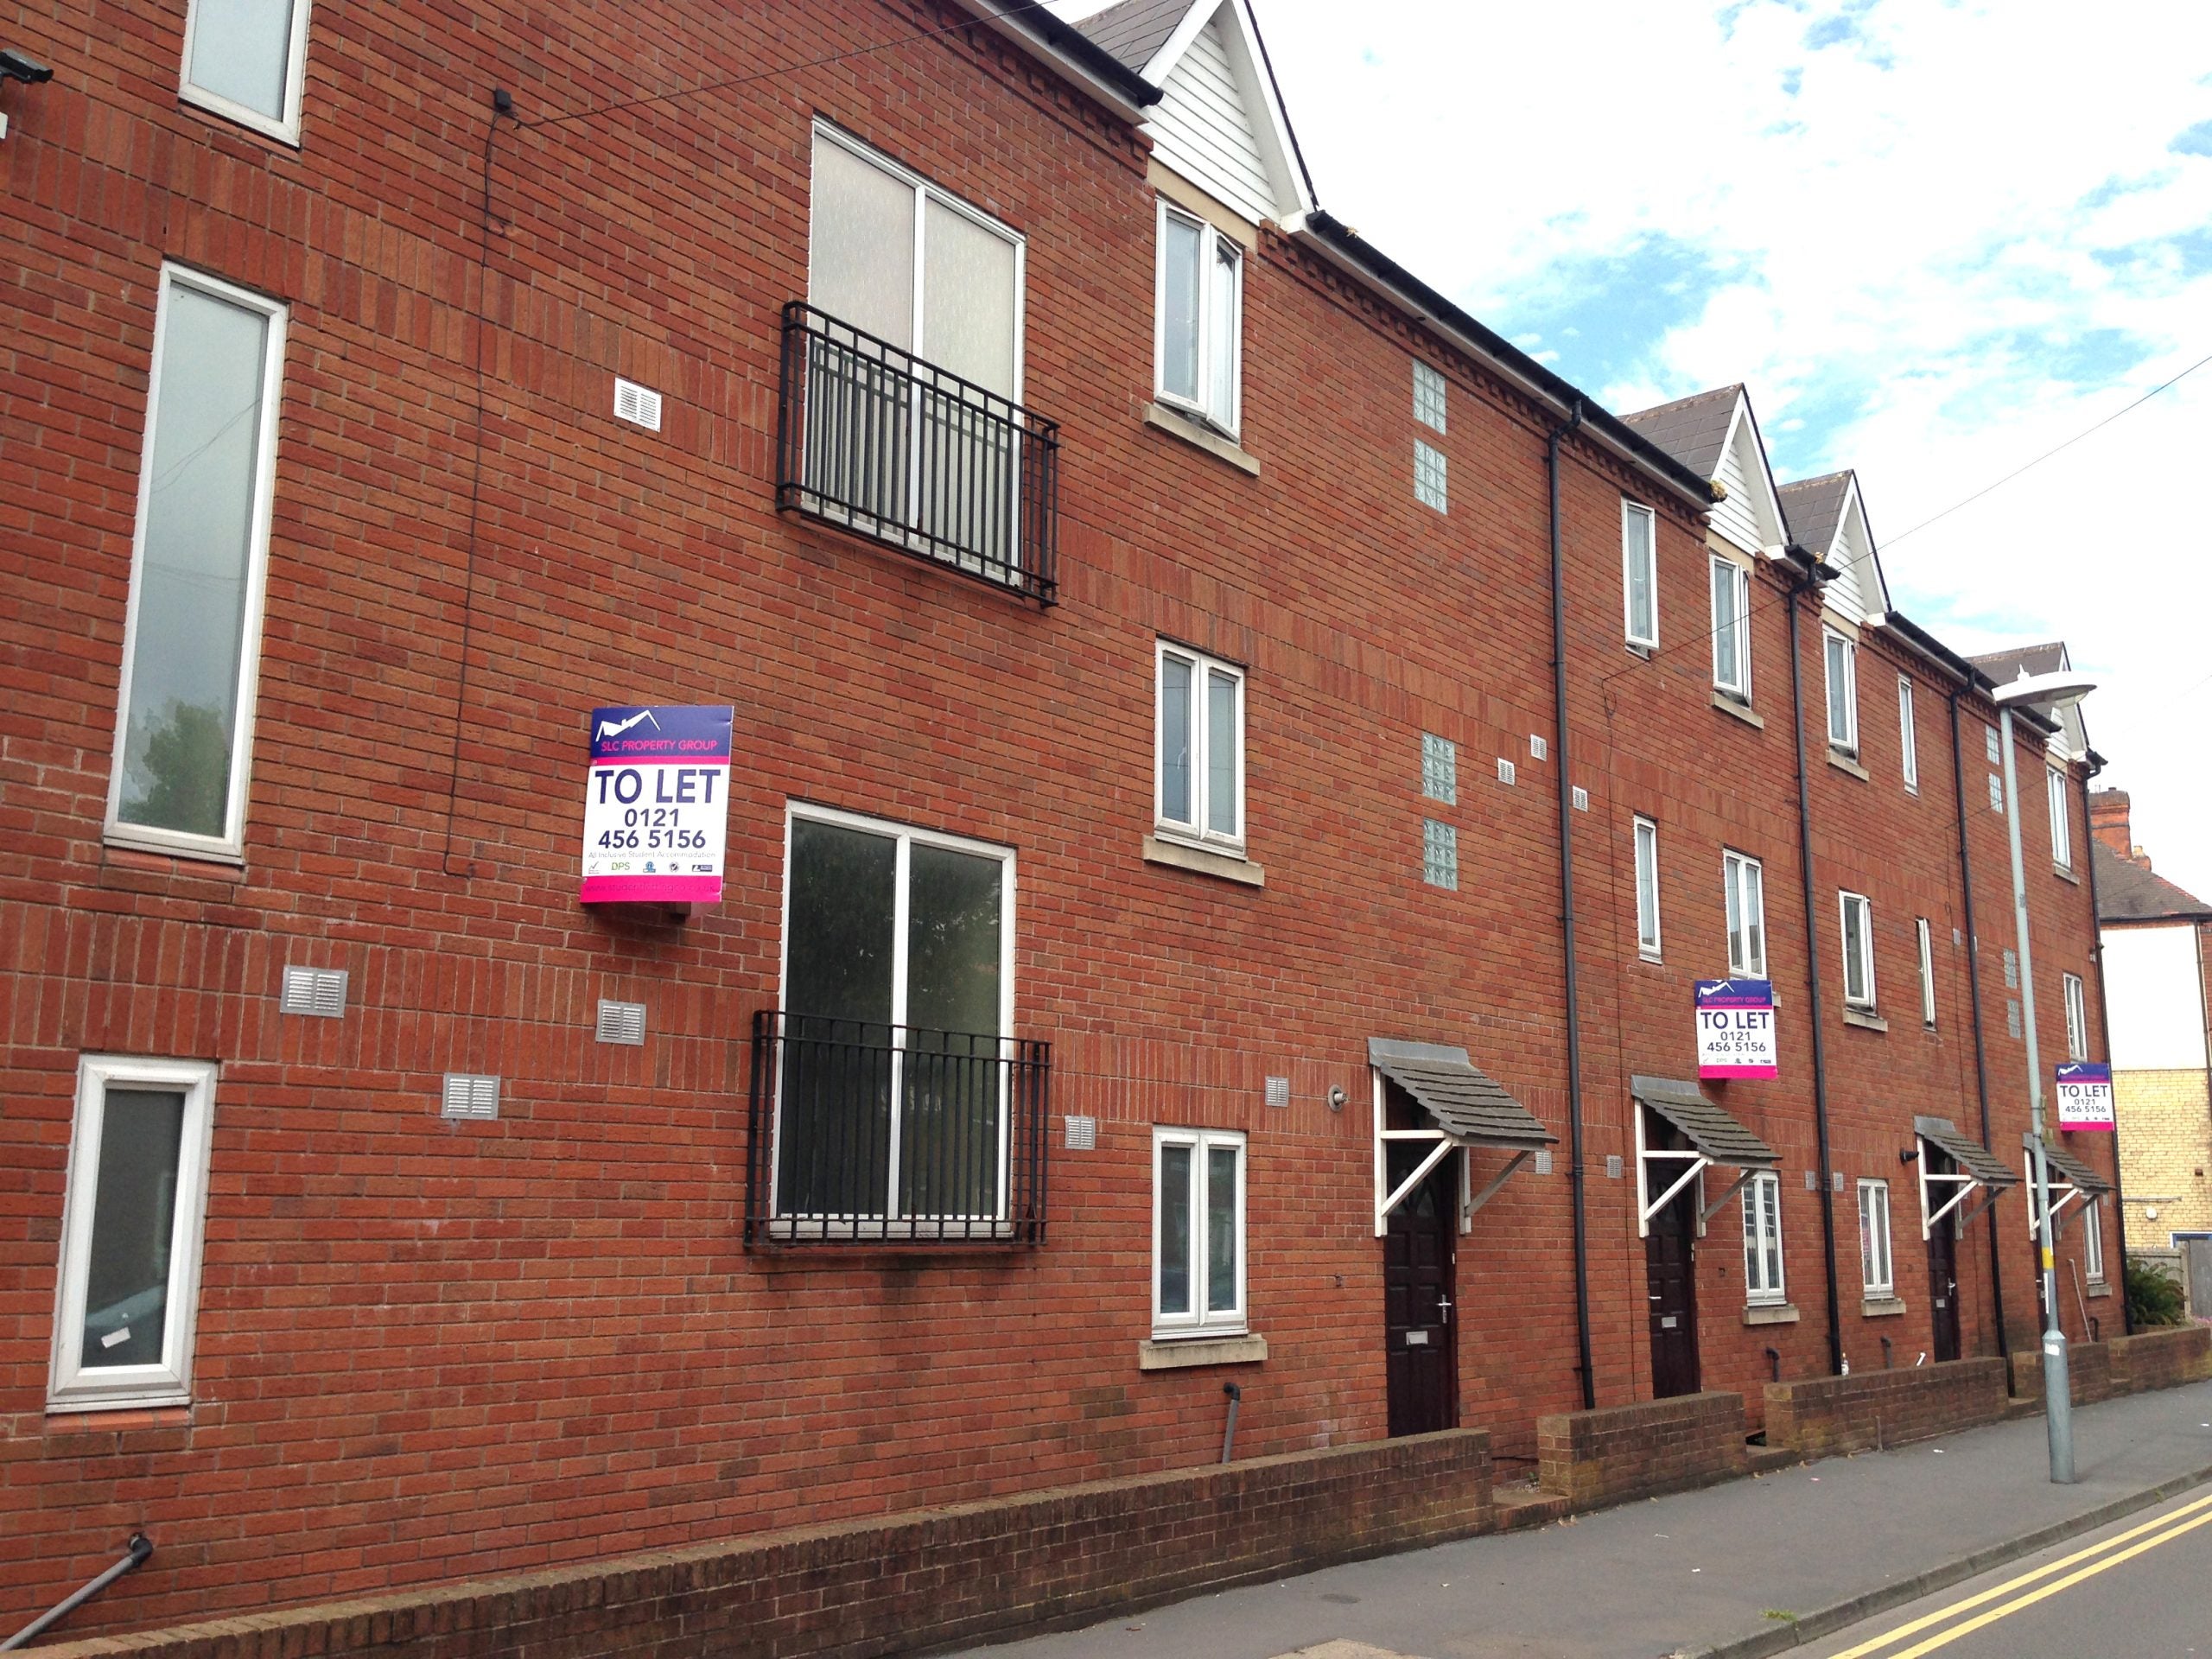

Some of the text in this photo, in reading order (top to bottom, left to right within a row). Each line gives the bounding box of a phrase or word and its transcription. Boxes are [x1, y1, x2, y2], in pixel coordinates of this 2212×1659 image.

[601, 740, 718, 752] SLC PROPERTY GROUP
[594, 768, 721, 804] TO LET
[624, 808, 679, 827] 0121
[598, 830, 706, 849] 456 5156
[611, 861, 631, 871] DPS
[1700, 1011, 1770, 1029] TO LET
[1720, 1031, 1751, 1041] 0121
[1707, 1042, 1766, 1052] 456 5156
[2059, 1085, 2108, 1097] TO LET
